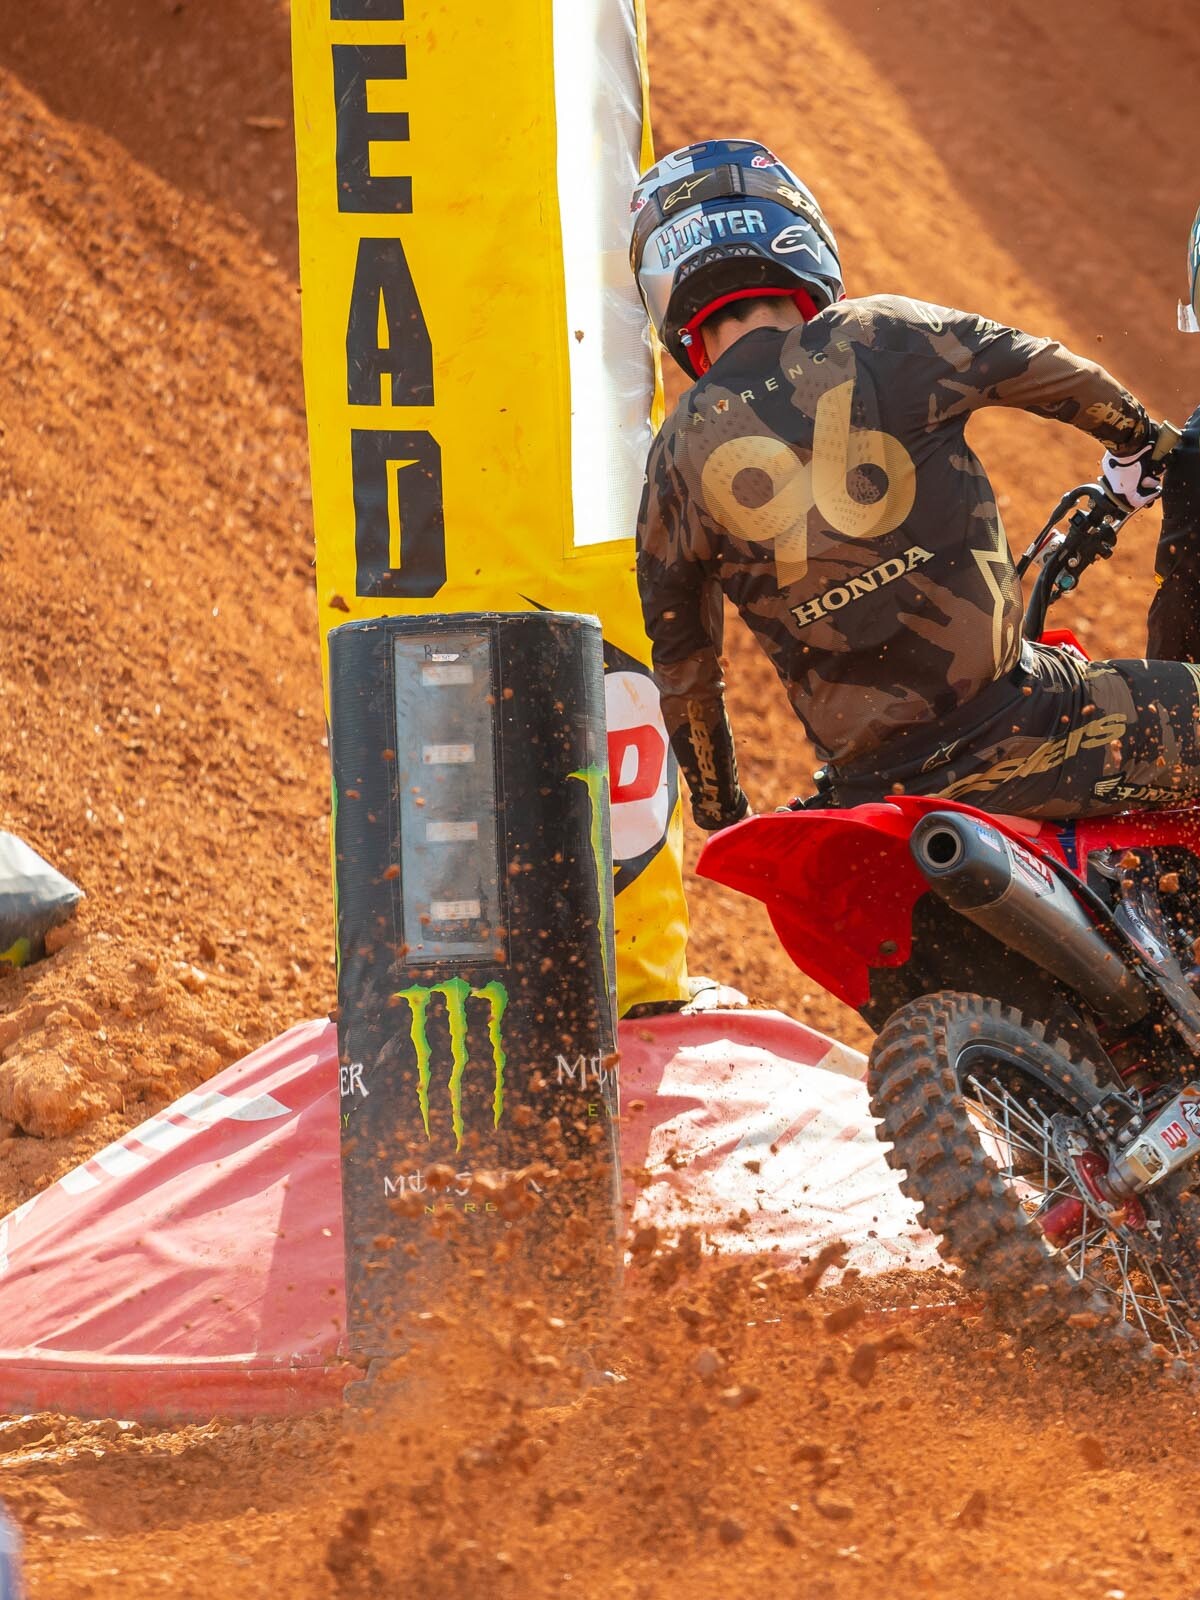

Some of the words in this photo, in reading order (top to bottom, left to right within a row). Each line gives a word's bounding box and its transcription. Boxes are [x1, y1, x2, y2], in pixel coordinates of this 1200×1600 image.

[655, 209, 767, 269] HUNTER
[330, 0, 447, 598] EAD
[678, 340, 850, 439] LAWRENCE
[702, 378, 917, 589] 96
[791, 545, 935, 627] HONDA
